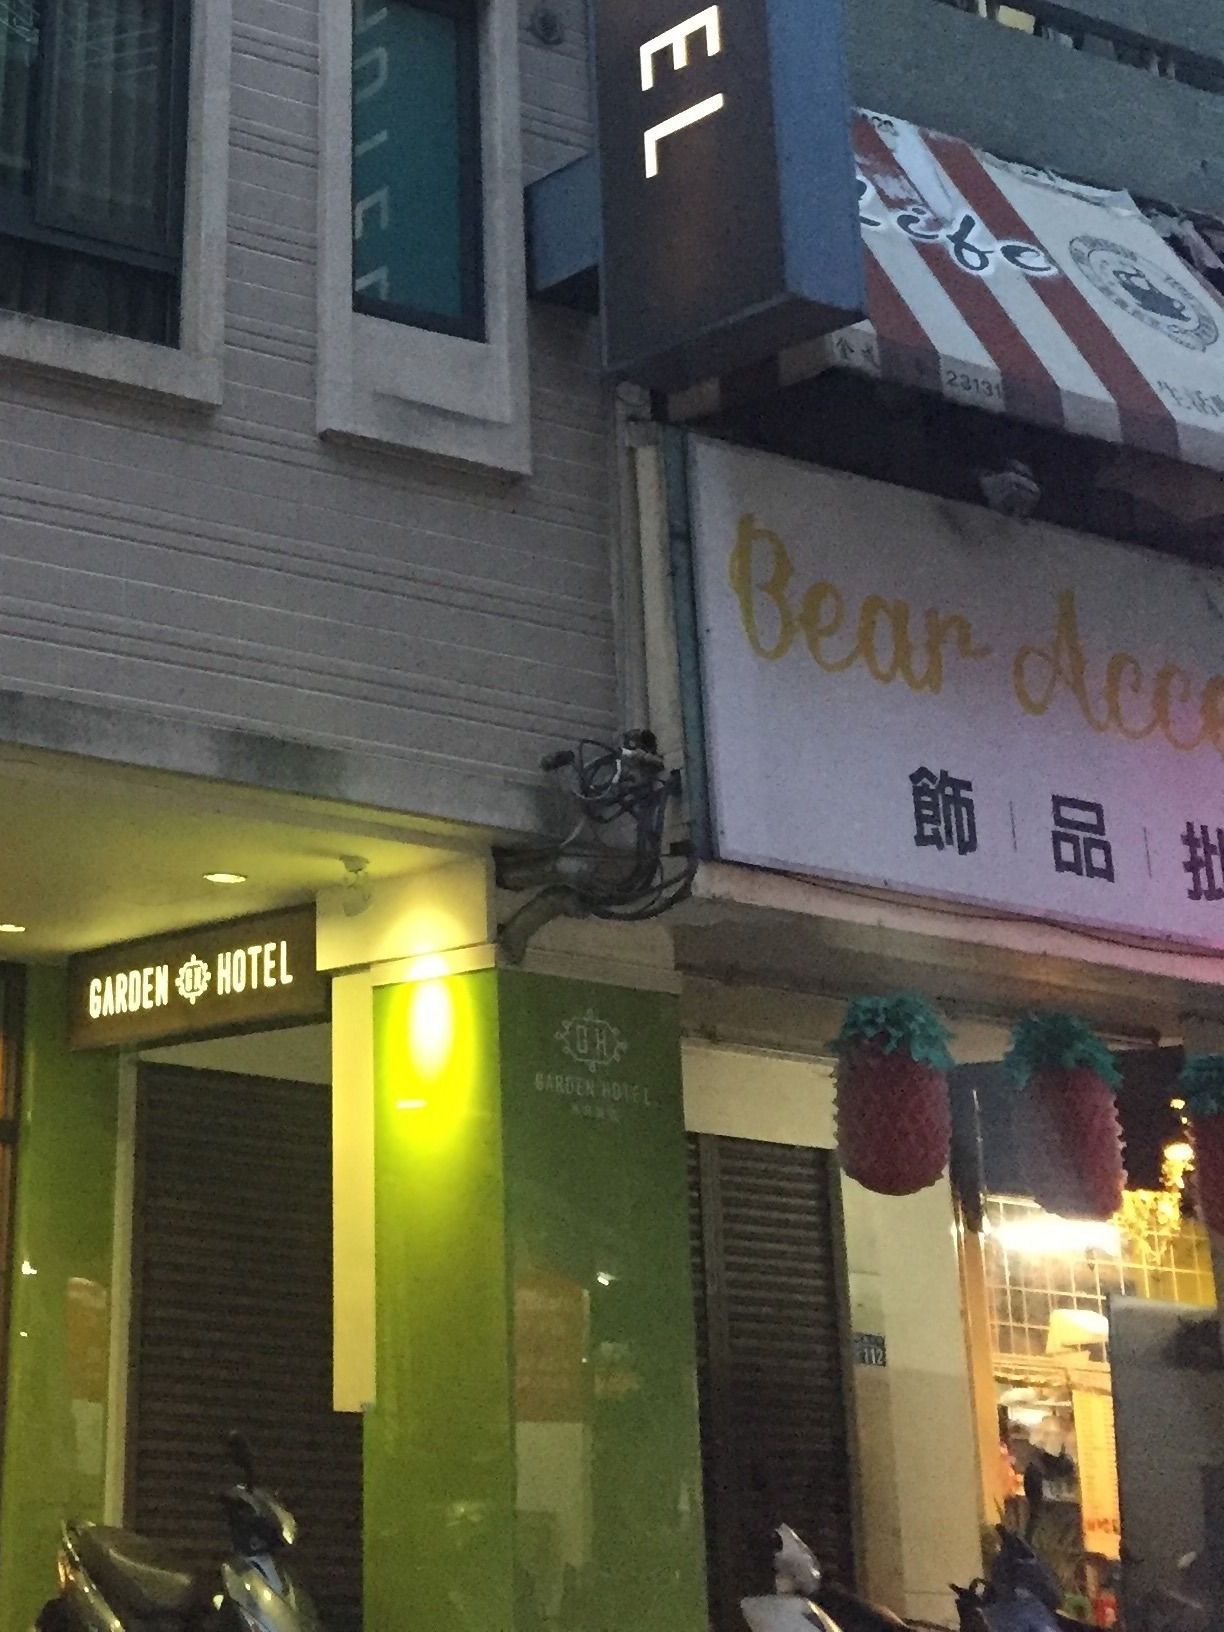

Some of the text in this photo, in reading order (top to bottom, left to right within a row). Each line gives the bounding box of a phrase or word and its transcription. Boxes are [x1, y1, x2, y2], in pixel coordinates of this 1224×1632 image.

[729, 512, 990, 695] Bear
[89, 964, 169, 1019] GARDEN
[217, 941, 294, 995] HOTEL
[535, 1072, 595, 1098] GARDEN
